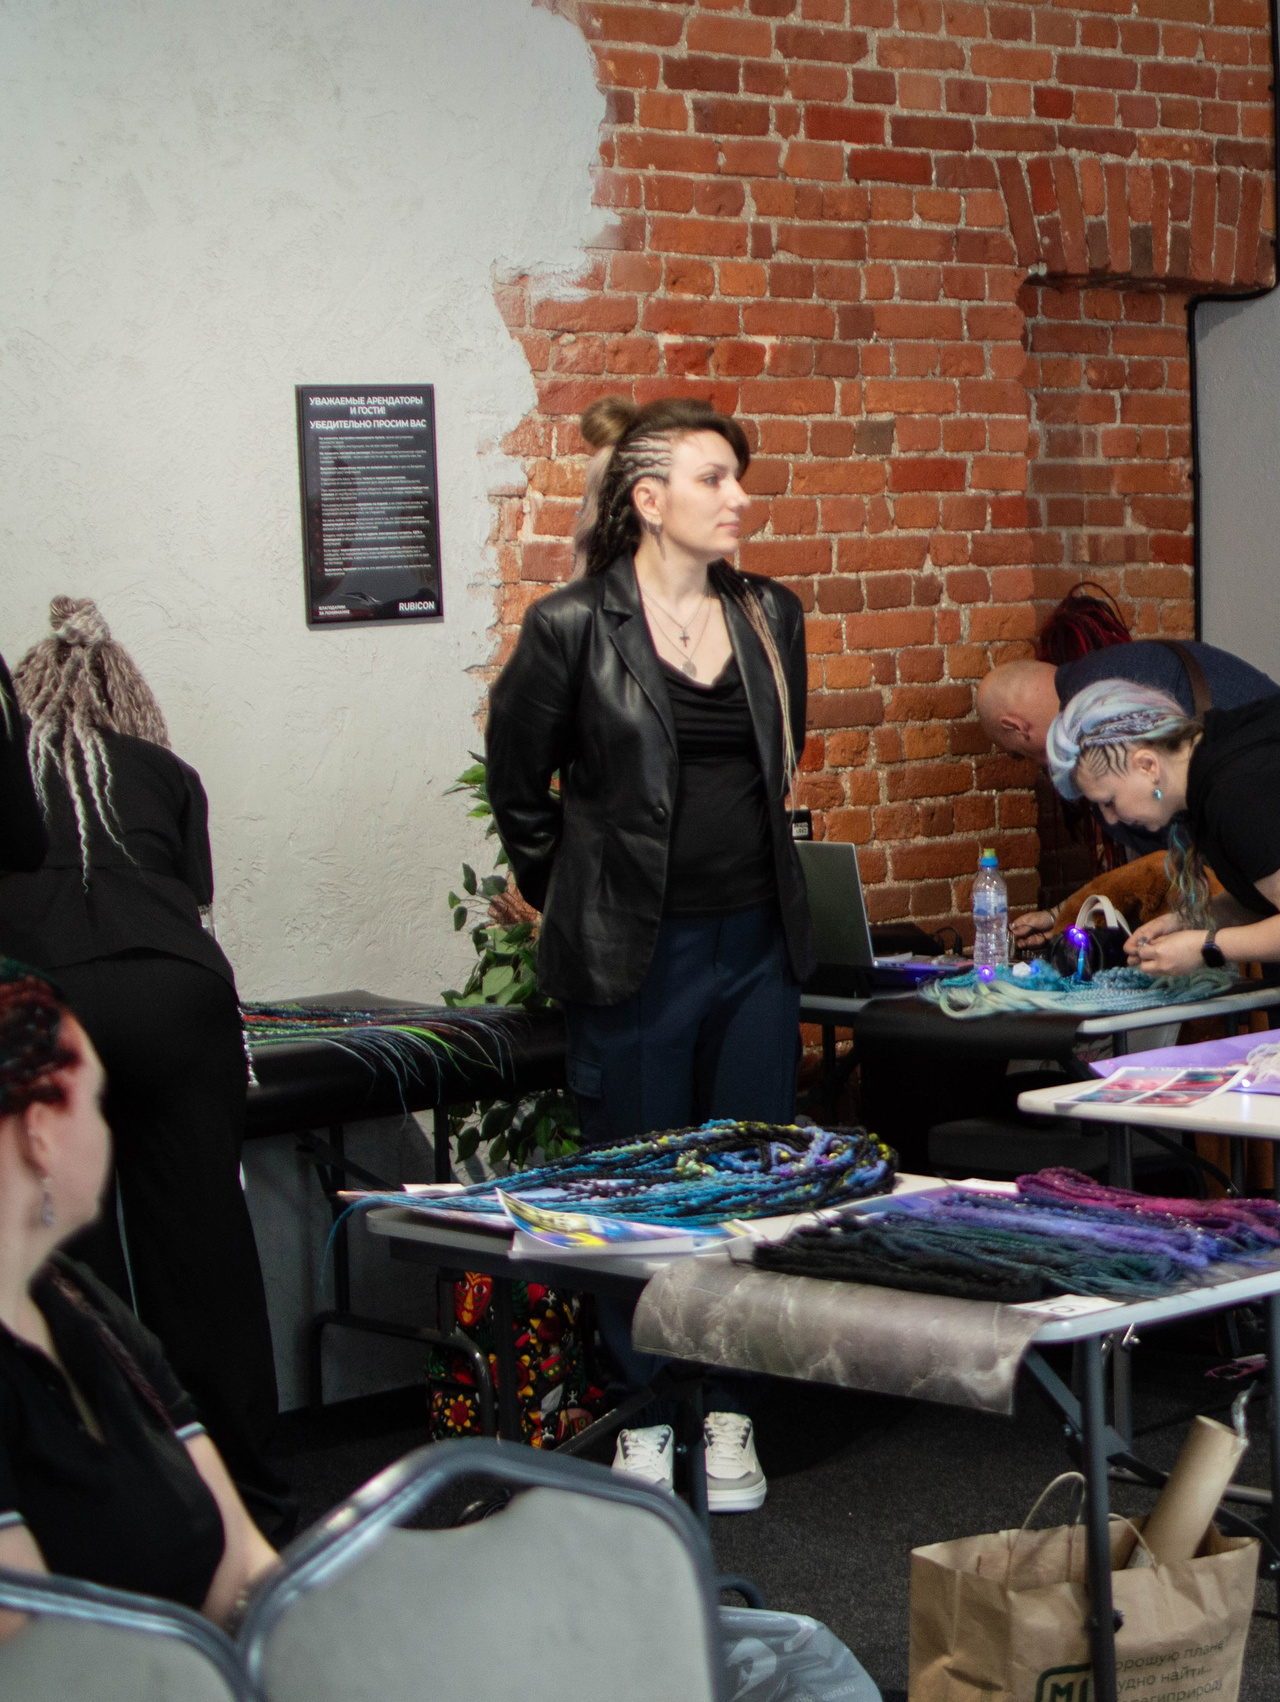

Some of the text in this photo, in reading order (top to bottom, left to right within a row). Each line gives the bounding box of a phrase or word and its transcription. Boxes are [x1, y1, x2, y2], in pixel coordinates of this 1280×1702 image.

[309, 396, 424, 406] УВАЖАЕМЫЕ АРЕНДАТОРЫ
[349, 406, 386, 415] И ГОСТИ!
[309, 418, 427, 430] УБЕДИТЕЛЬНО ПРОСИМ ВАС
[398, 601, 436, 611] RUBICON
[1116, 1635, 1231, 1673] орошую плане
[1117, 1674, 1156, 1694] удно
